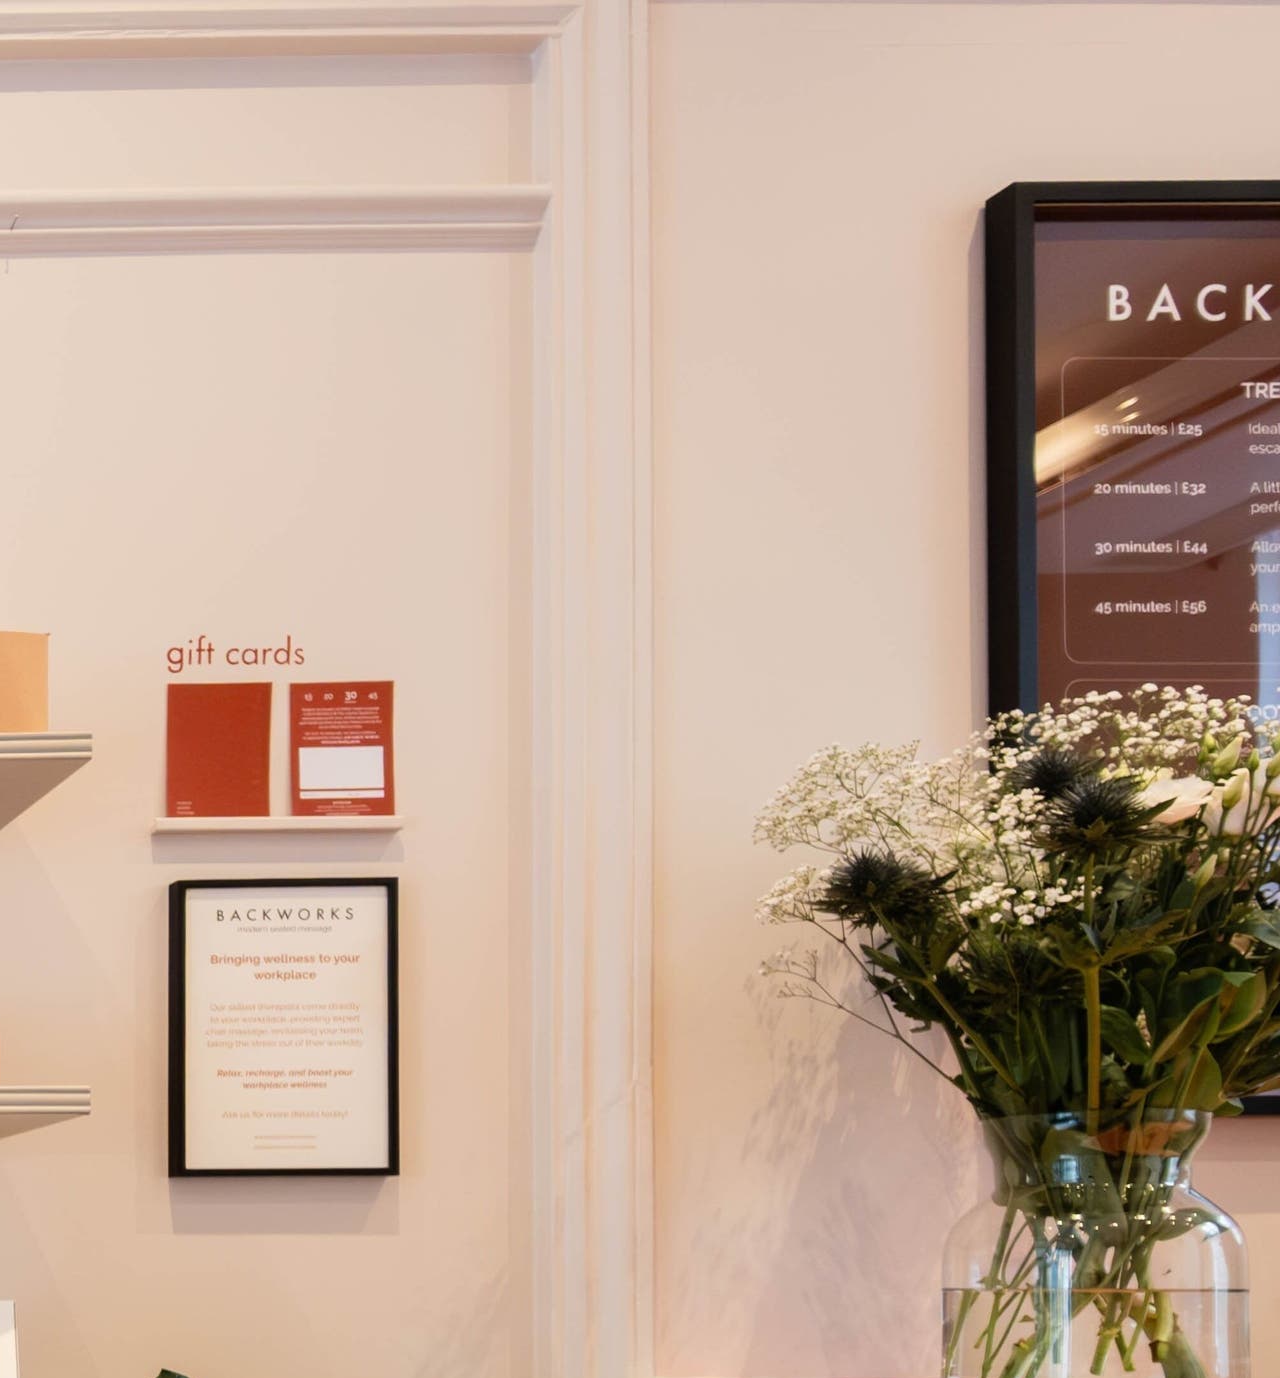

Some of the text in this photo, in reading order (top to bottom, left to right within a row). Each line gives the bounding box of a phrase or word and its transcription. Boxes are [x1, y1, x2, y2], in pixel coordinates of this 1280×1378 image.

[1107, 283, 1275, 322] BACK
[1112, 423, 1168, 435] minutes
[1178, 423, 1203, 437] £25
[1094, 483, 1111, 494] 20
[1114, 482, 1172, 494] minutes
[1182, 482, 1206, 495] £32
[1250, 501, 1280, 516] perf
[1095, 542, 1112, 555] 30
[1116, 541, 1173, 553] minutes
[1183, 541, 1208, 554] £44
[1251, 541, 1280, 553] Allo
[1095, 602, 1112, 615] 45
[1115, 600, 1172, 613] minutes
[1182, 600, 1207, 614] £56
[167, 635, 305, 673] gift cards
[216, 907, 354, 922] BACKWORKS
[210, 953, 360, 967] Bringing wellness to your
[254, 969, 316, 982] workplace
